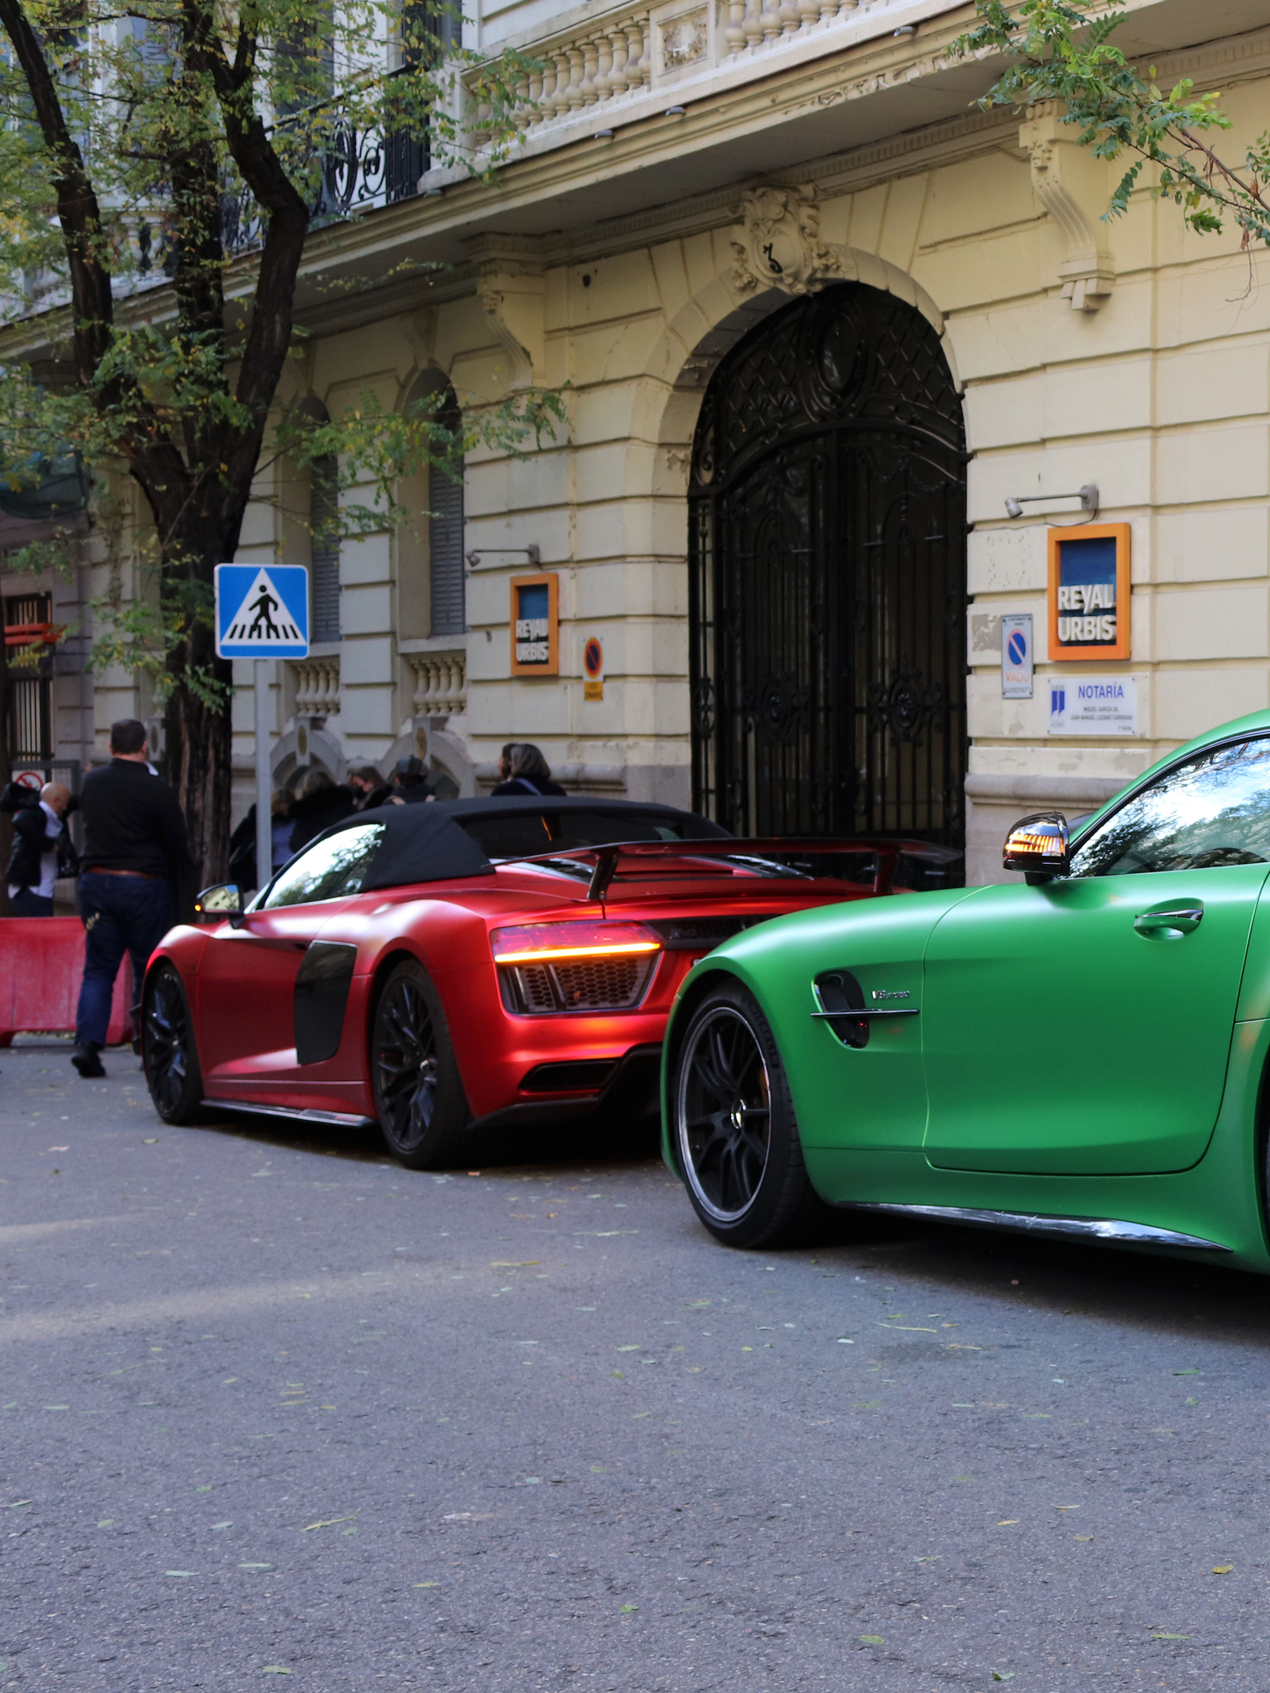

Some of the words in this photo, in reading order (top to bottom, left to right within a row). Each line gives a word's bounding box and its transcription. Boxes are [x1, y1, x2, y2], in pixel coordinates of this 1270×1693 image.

[1057, 584, 1114, 614] REYAL
[1057, 614, 1116, 642] URBIS
[516, 641, 549, 662] URBIS
[1005, 670, 1031, 684] VADO
[1078, 681, 1124, 699] NOTARÍA
